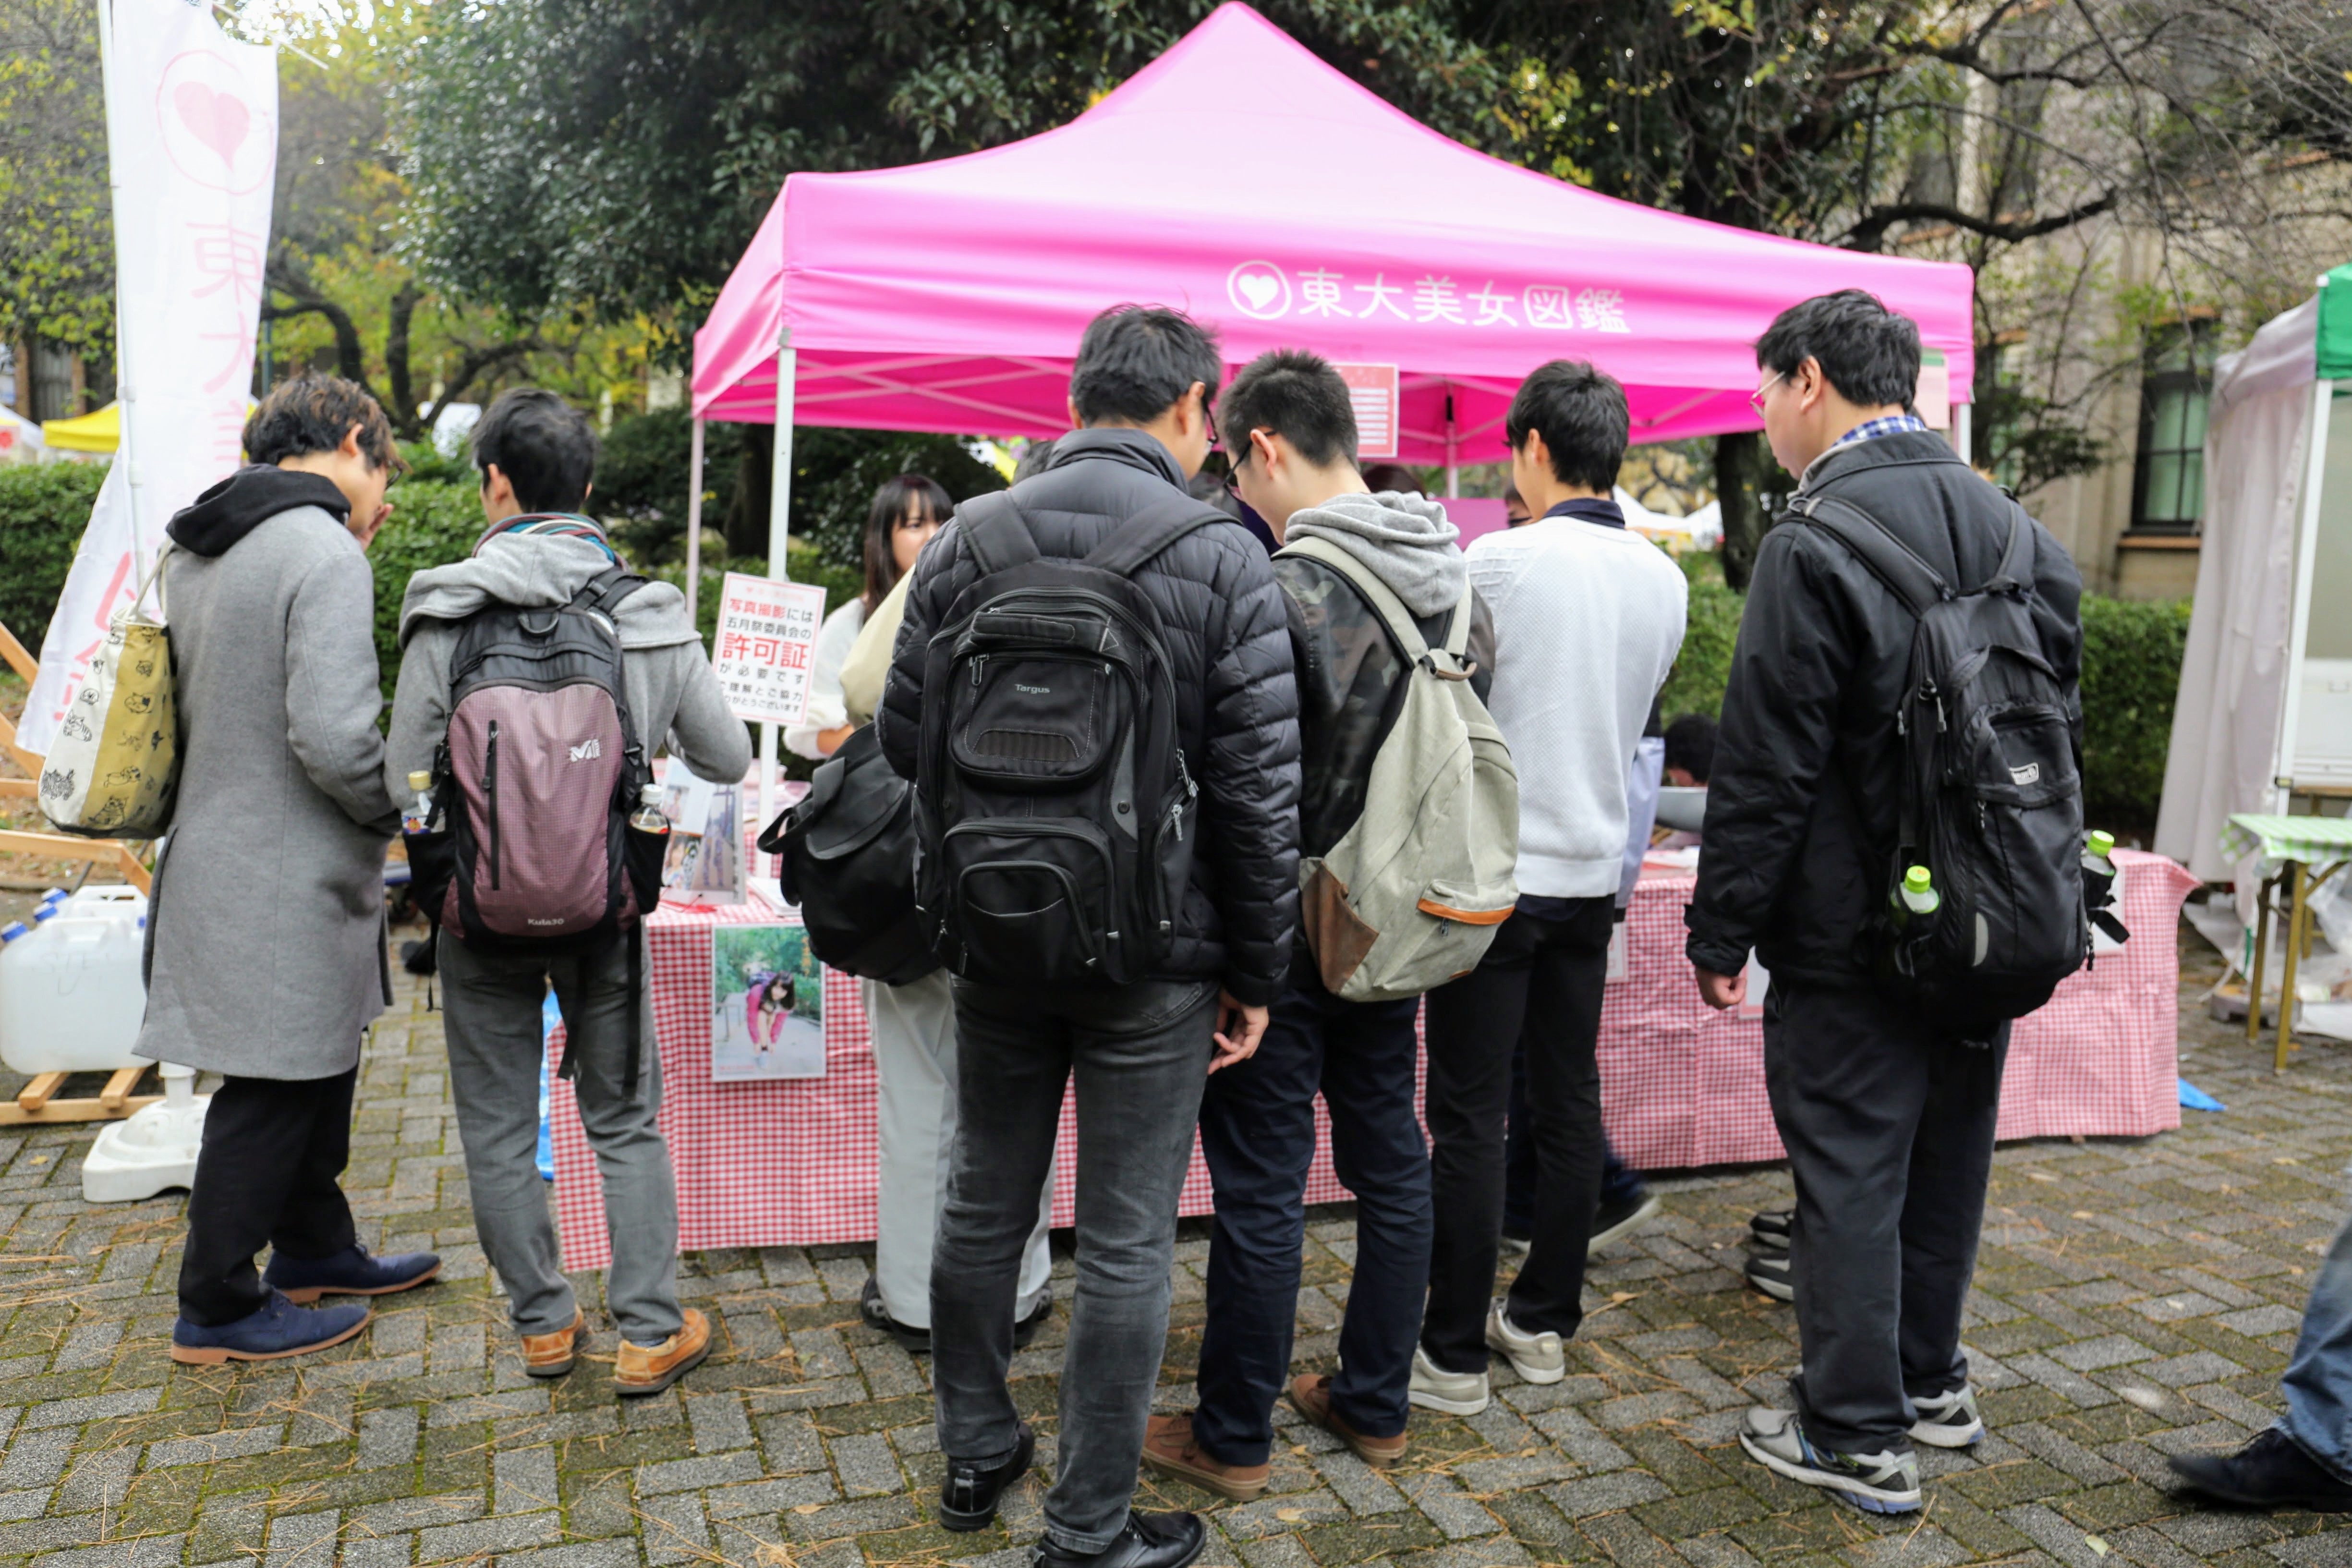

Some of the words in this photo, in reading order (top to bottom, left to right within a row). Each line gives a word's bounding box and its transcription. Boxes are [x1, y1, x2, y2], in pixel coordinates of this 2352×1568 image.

[1297, 267, 1632, 333] 東大美女図鑑
[729, 598, 814, 623] 写真撮影には
[726, 616, 812, 640] 五月祭委員会の
[722, 632, 809, 669] 許可証
[719, 662, 804, 684] が必要です
[1014, 684, 1050, 694] Targus
